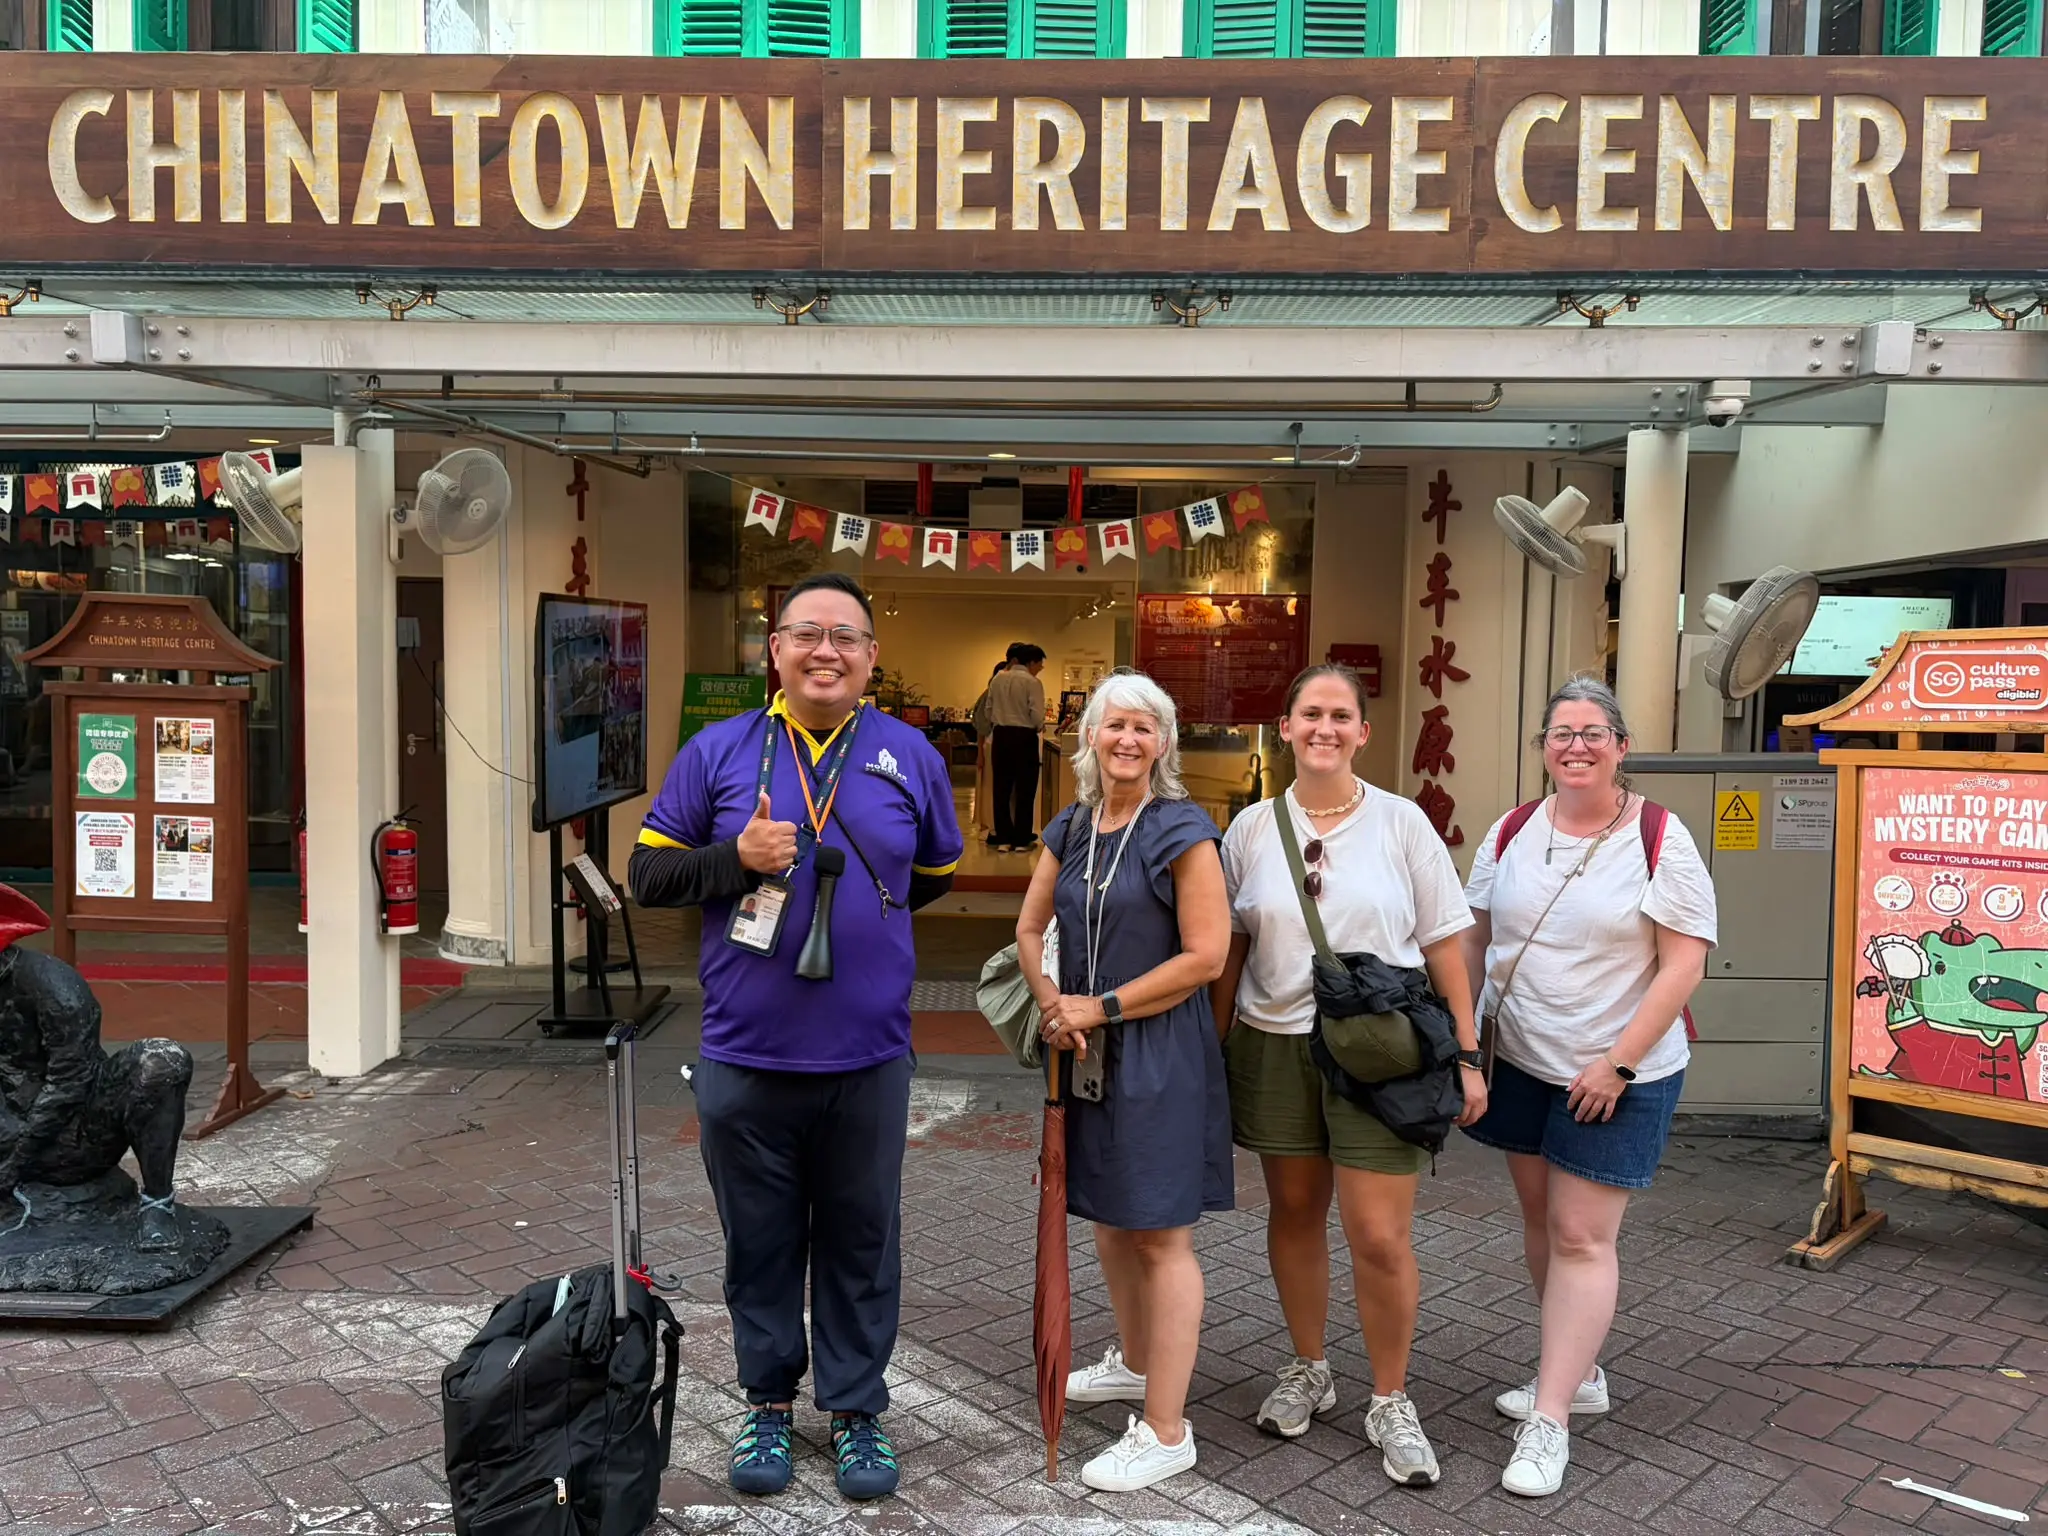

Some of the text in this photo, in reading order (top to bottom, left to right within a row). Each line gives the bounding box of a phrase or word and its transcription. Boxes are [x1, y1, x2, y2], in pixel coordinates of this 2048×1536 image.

[48, 88, 1987, 234] CHINATOWN HERITAGE CENTRE
[1246, 616, 1278, 625] Centre
[89, 634, 216, 650] CHINATOWN HERITAGE CENTRE
[1969, 661, 2041, 676] culture
[1930, 671, 1960, 687] SG
[1969, 676, 2017, 691] pass
[1997, 690, 2040, 700] eligible!
[866, 762, 907, 780] MONER
[1898, 794, 2047, 821] WANT TO PLAY
[1874, 816, 1990, 844] MYSTERY
[1900, 851, 1941, 862] COLLECT
[1944, 854, 1969, 865] YOUR
[1972, 857, 2000, 867] GAME
[2002, 859, 2023, 869] KITS
[2039, 1044, 2048, 1053] SC
